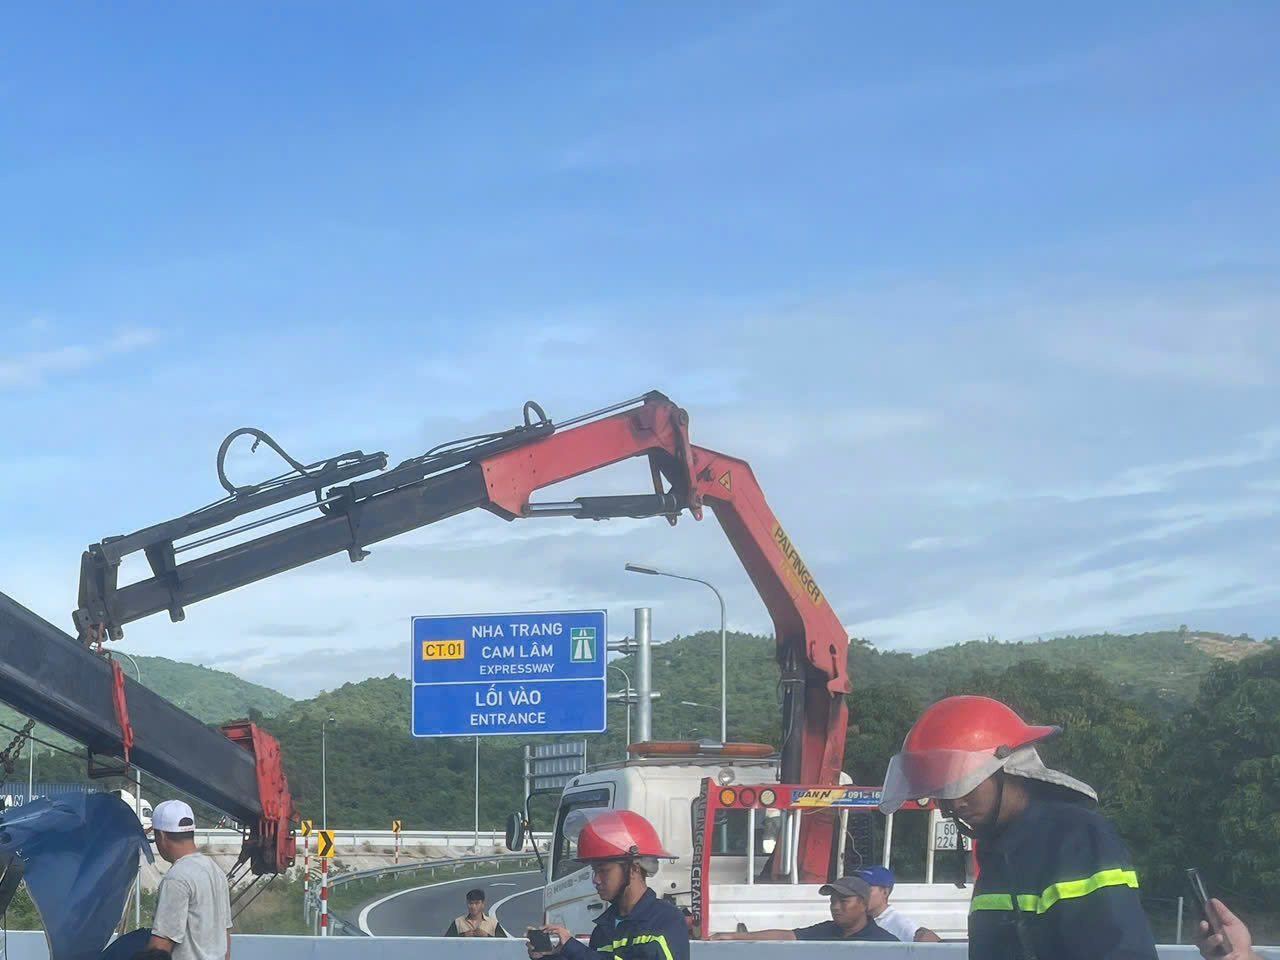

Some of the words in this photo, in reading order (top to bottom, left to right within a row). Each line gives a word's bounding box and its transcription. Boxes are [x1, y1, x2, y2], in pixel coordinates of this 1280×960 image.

[774, 527, 821, 602] PALFINGER
[472, 625, 504, 639] NHA
[510, 623, 563, 637] TRANG
[425, 643, 461, 657] CT.01
[482, 645, 515, 659] CAM
[520, 641, 553, 657] LÂM
[479, 663, 555, 675] EXPRESSWAY
[476, 684, 503, 707] LỐI
[508, 685, 541, 705] VÀO
[470, 712, 546, 726] ENTRANCE
